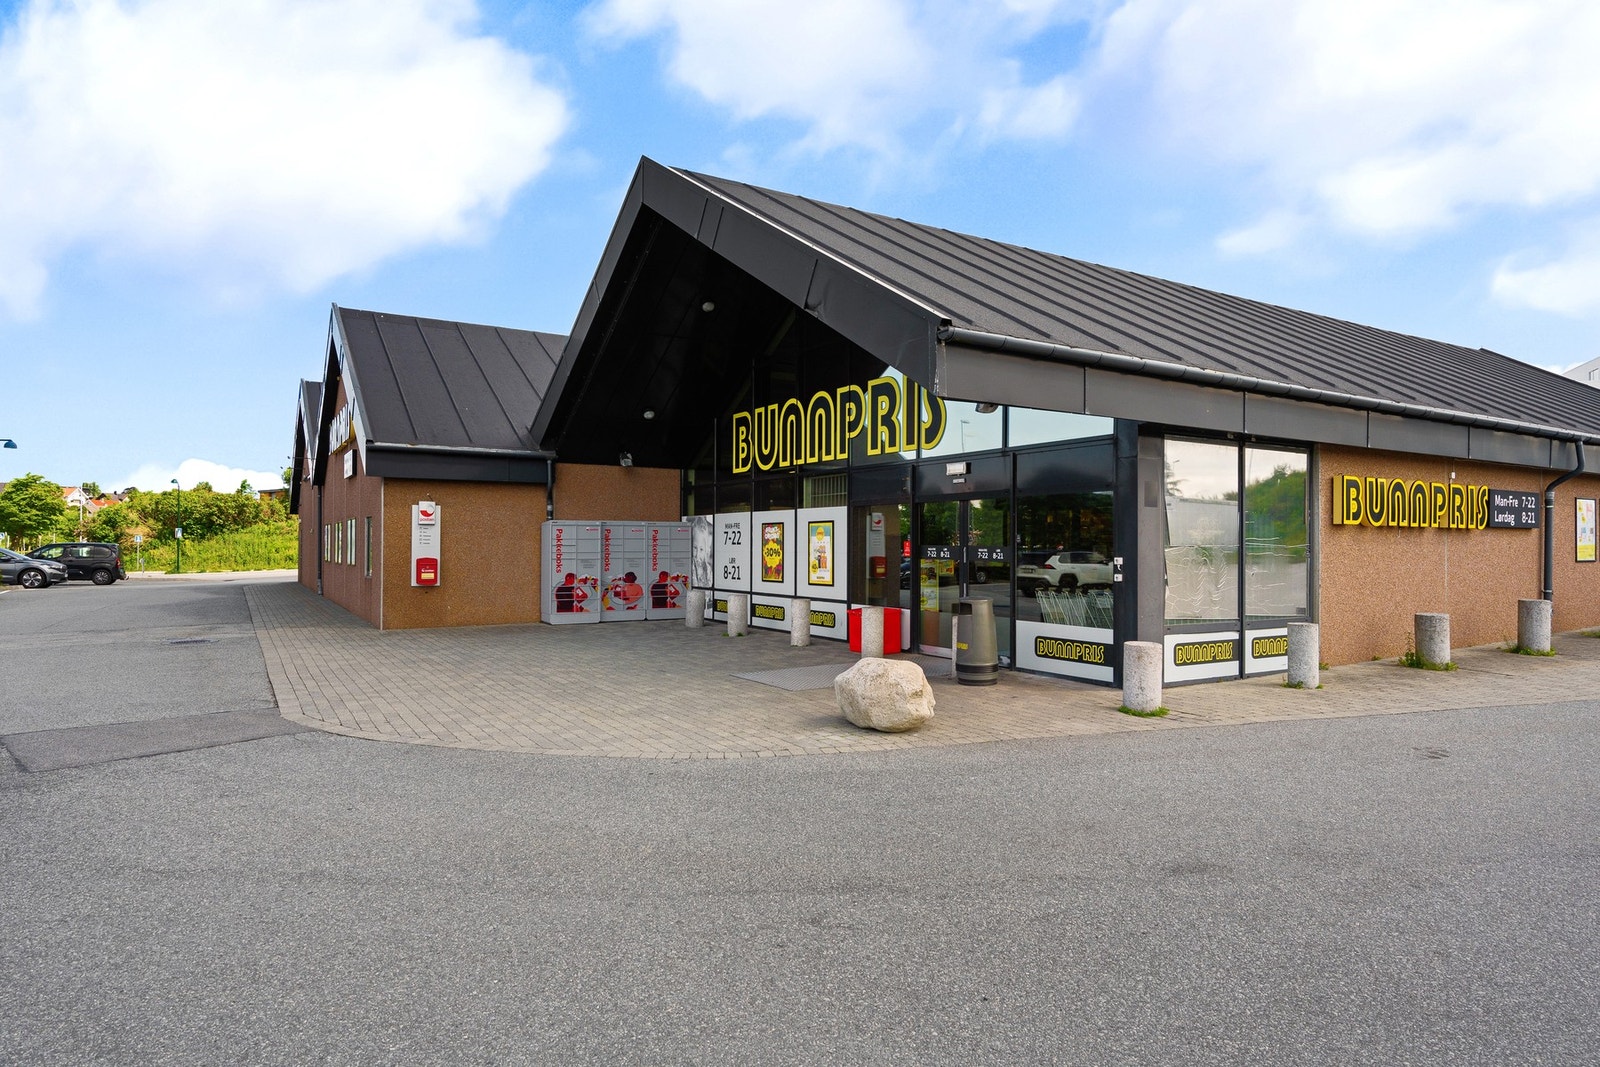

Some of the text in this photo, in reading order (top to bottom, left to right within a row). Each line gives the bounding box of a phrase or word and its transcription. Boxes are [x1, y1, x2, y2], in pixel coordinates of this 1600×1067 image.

[732, 375, 947, 474] BUNNPRIS
[1338, 474, 1489, 530] BUNNPRIS
[1494, 494, 1536, 509] Man-Fre 7-22
[1494, 511, 1536, 526] Lørdag 8-21
[603, 528, 612, 572] Pakkeboks
[651, 529, 659, 571] Pakkeboks
[723, 531, 742, 545] 7-22
[555, 528, 564, 574] Pakkeboks
[723, 565, 741, 580] 8-21
[1036, 637, 1105, 664] BUNNPRIS
[1175, 641, 1233, 664] BUNNPRIS
[1253, 637, 1288, 657] BUNNP
